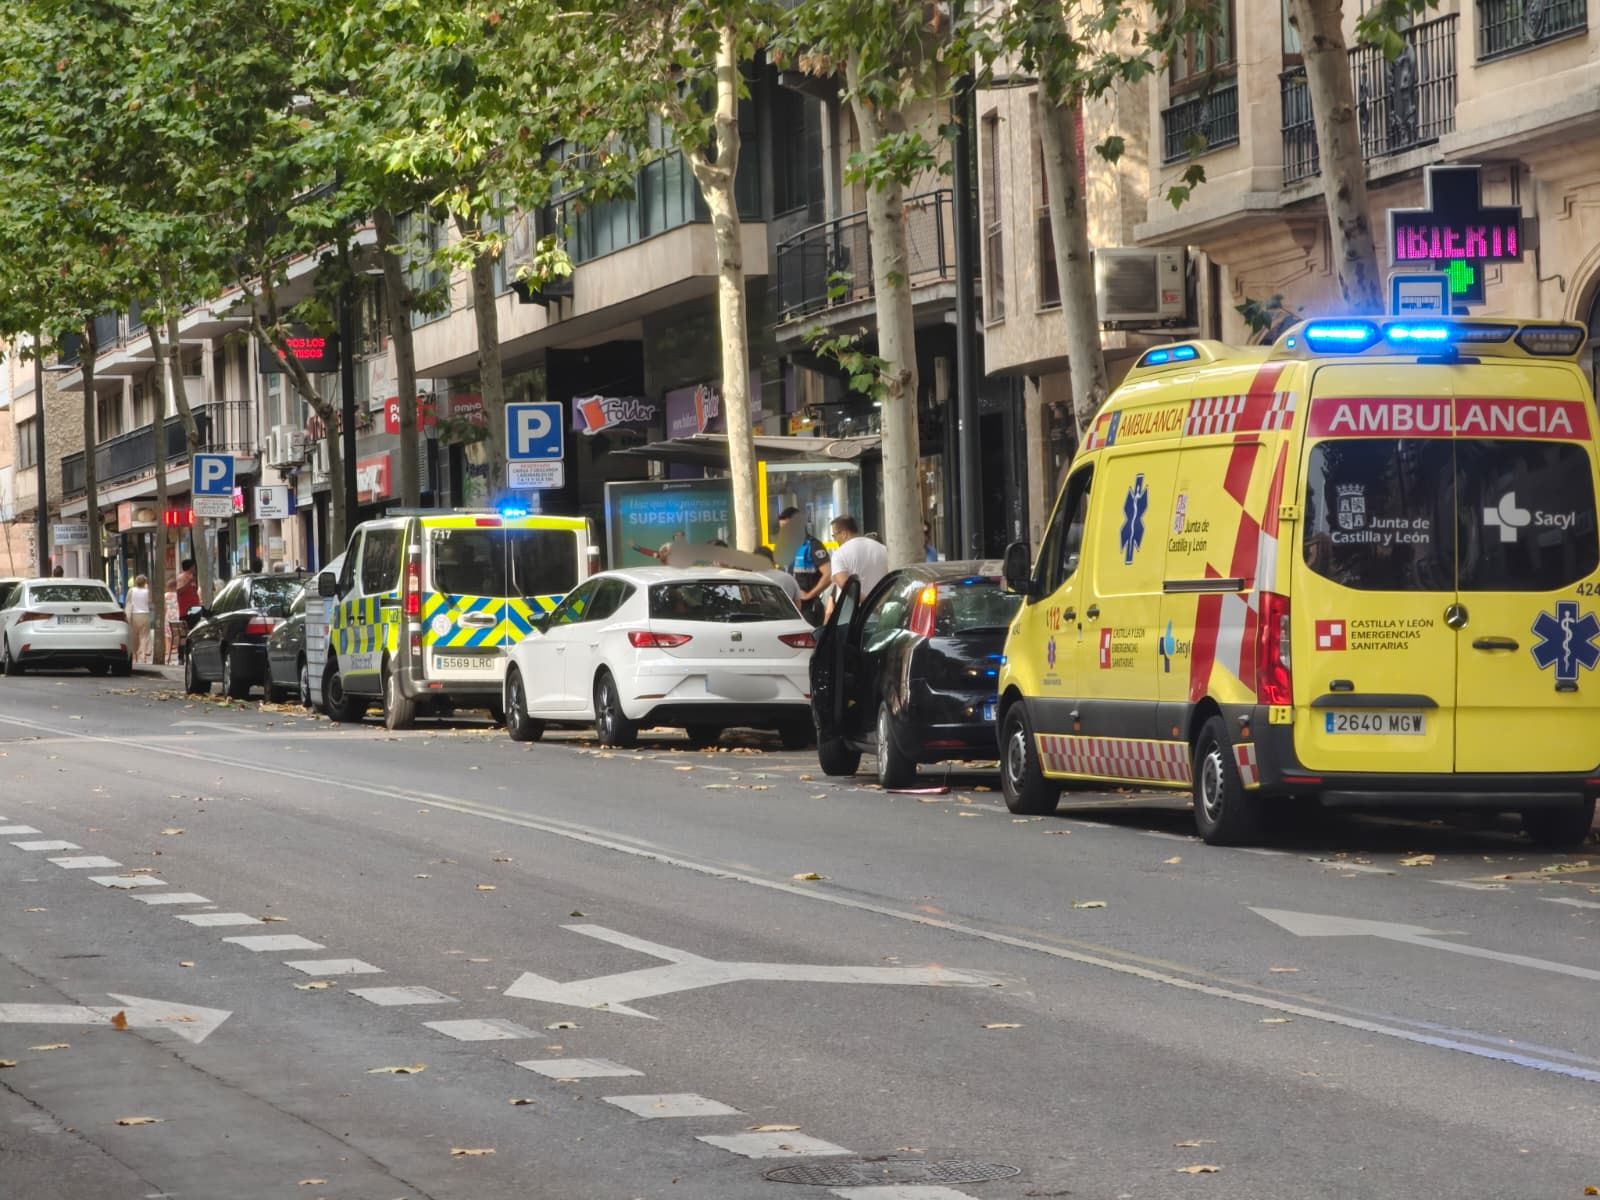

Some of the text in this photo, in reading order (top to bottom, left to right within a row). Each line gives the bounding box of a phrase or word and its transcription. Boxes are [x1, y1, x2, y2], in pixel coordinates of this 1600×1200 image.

[602, 399, 655, 422] Folder
[1118, 408, 1184, 437] AMBULANCIA
[1328, 404, 1573, 433] AMBULANCIA
[518, 410, 551, 453] P
[201, 459, 227, 491] P
[629, 510, 728, 524] SUPERVISIBLE
[1369, 516, 1430, 529] Junta de
[1534, 511, 1575, 530] Sacyl
[1184, 520, 1209, 533] Junta de
[434, 530, 452, 540] 717
[1331, 531, 1430, 546] Castilla y León
[1168, 538, 1187, 552] Castilla
[1193, 538, 1208, 552] León
[1576, 582, 1600, 596] 424
[1351, 619, 1396, 628] CASTILLA
[1398, 619, 1405, 628] Y
[1351, 630, 1421, 639] EMERGENCIAS
[1176, 639, 1191, 659] Sacyl
[1351, 641, 1409, 650] SANITARIAS
[443, 657, 469, 668] 5569
[1337, 714, 1422, 732] 2640 MGW
